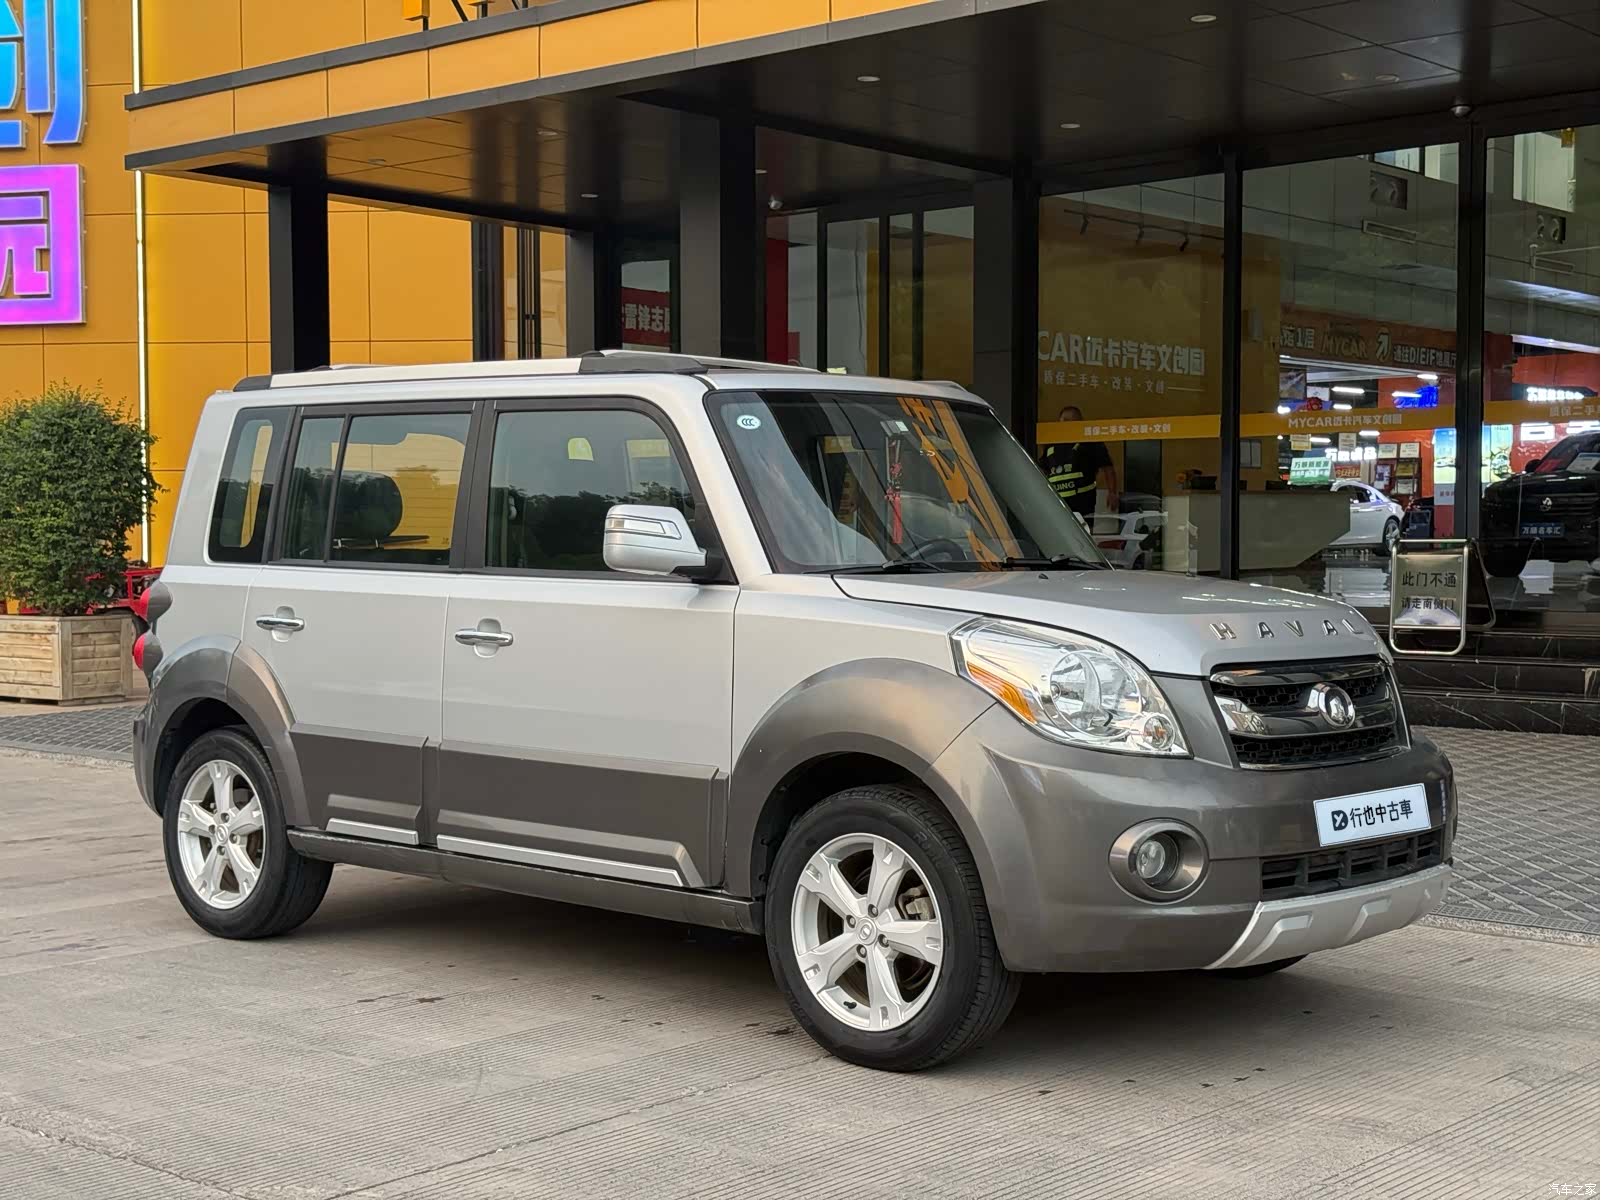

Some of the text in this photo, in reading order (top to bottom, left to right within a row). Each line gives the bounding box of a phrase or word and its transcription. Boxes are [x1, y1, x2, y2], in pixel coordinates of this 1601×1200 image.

[1402, 572, 1457, 588] 此门不通
[1401, 597, 1454, 610] 请走南侧门
[1208, 618, 1363, 641] HAVAL
[1349, 799, 1414, 829] 行也中古車
